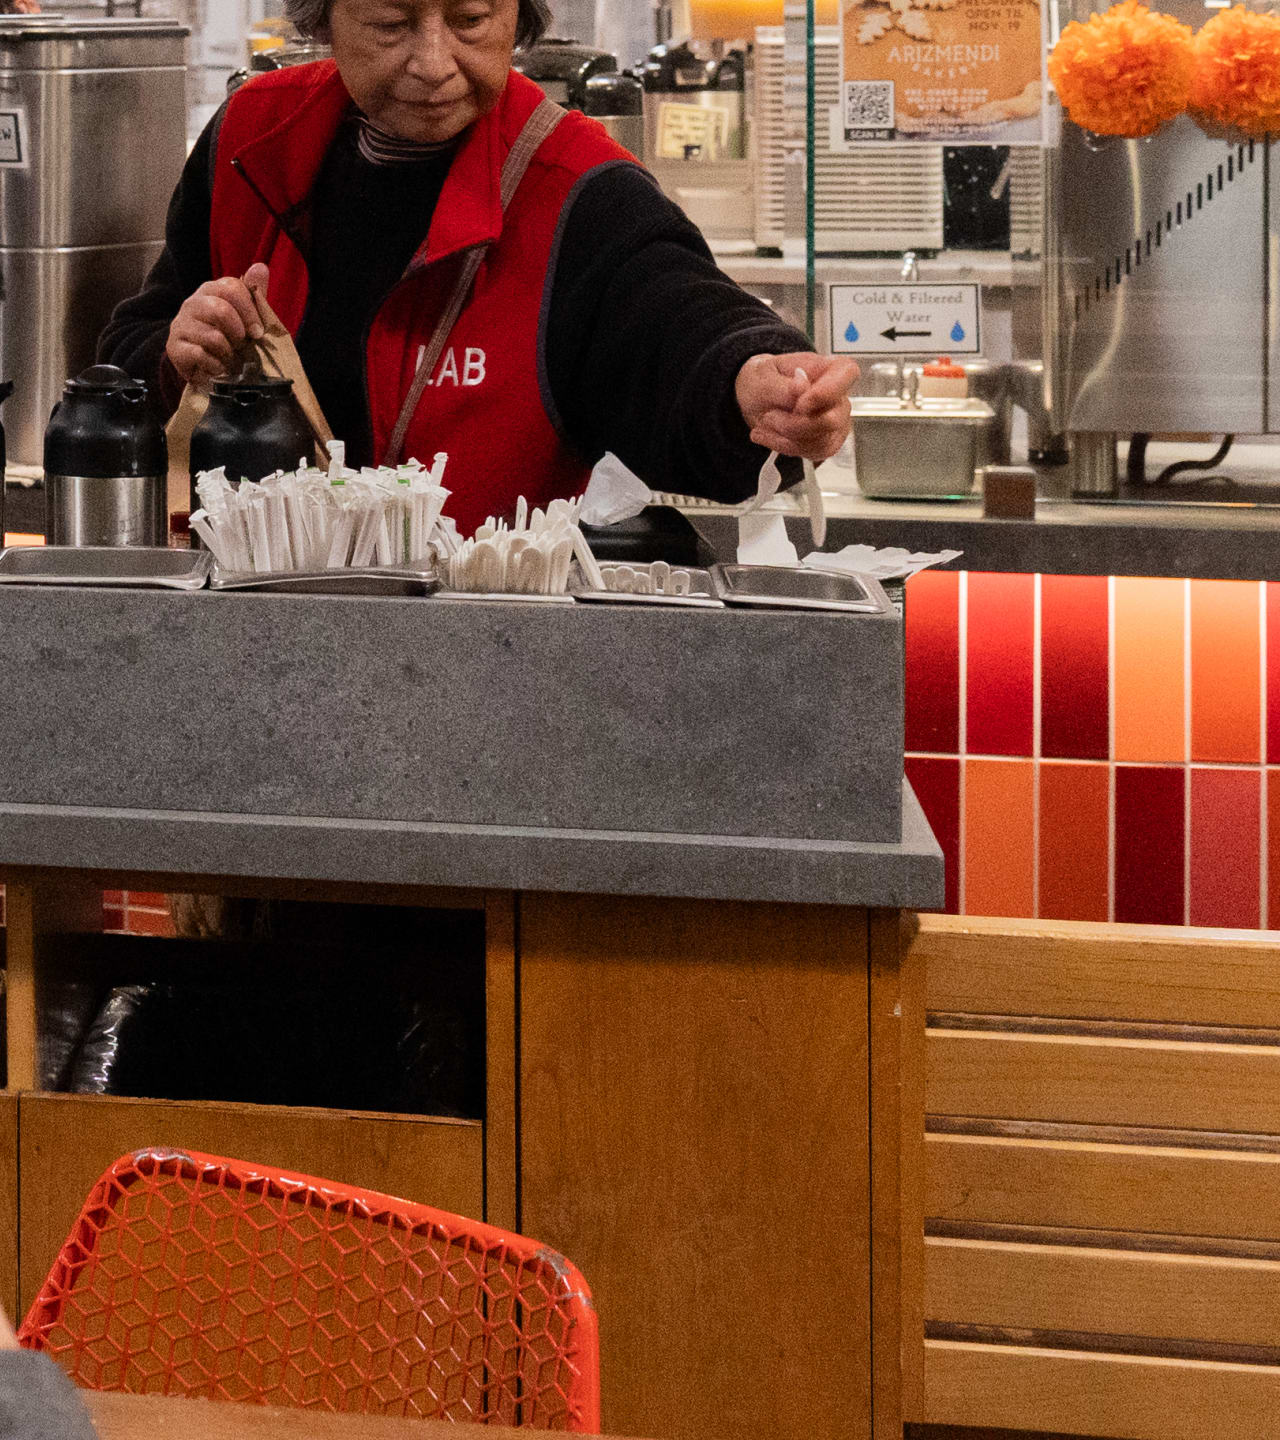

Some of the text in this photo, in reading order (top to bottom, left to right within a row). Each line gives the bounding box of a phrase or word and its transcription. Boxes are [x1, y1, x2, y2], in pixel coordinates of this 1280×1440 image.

[887, 44, 1001, 62] ARIZMENDI
[849, 130, 889, 140] SCAN ME
[853, 291, 963, 305] Cold & Filtered
[886, 310, 932, 323] Water
